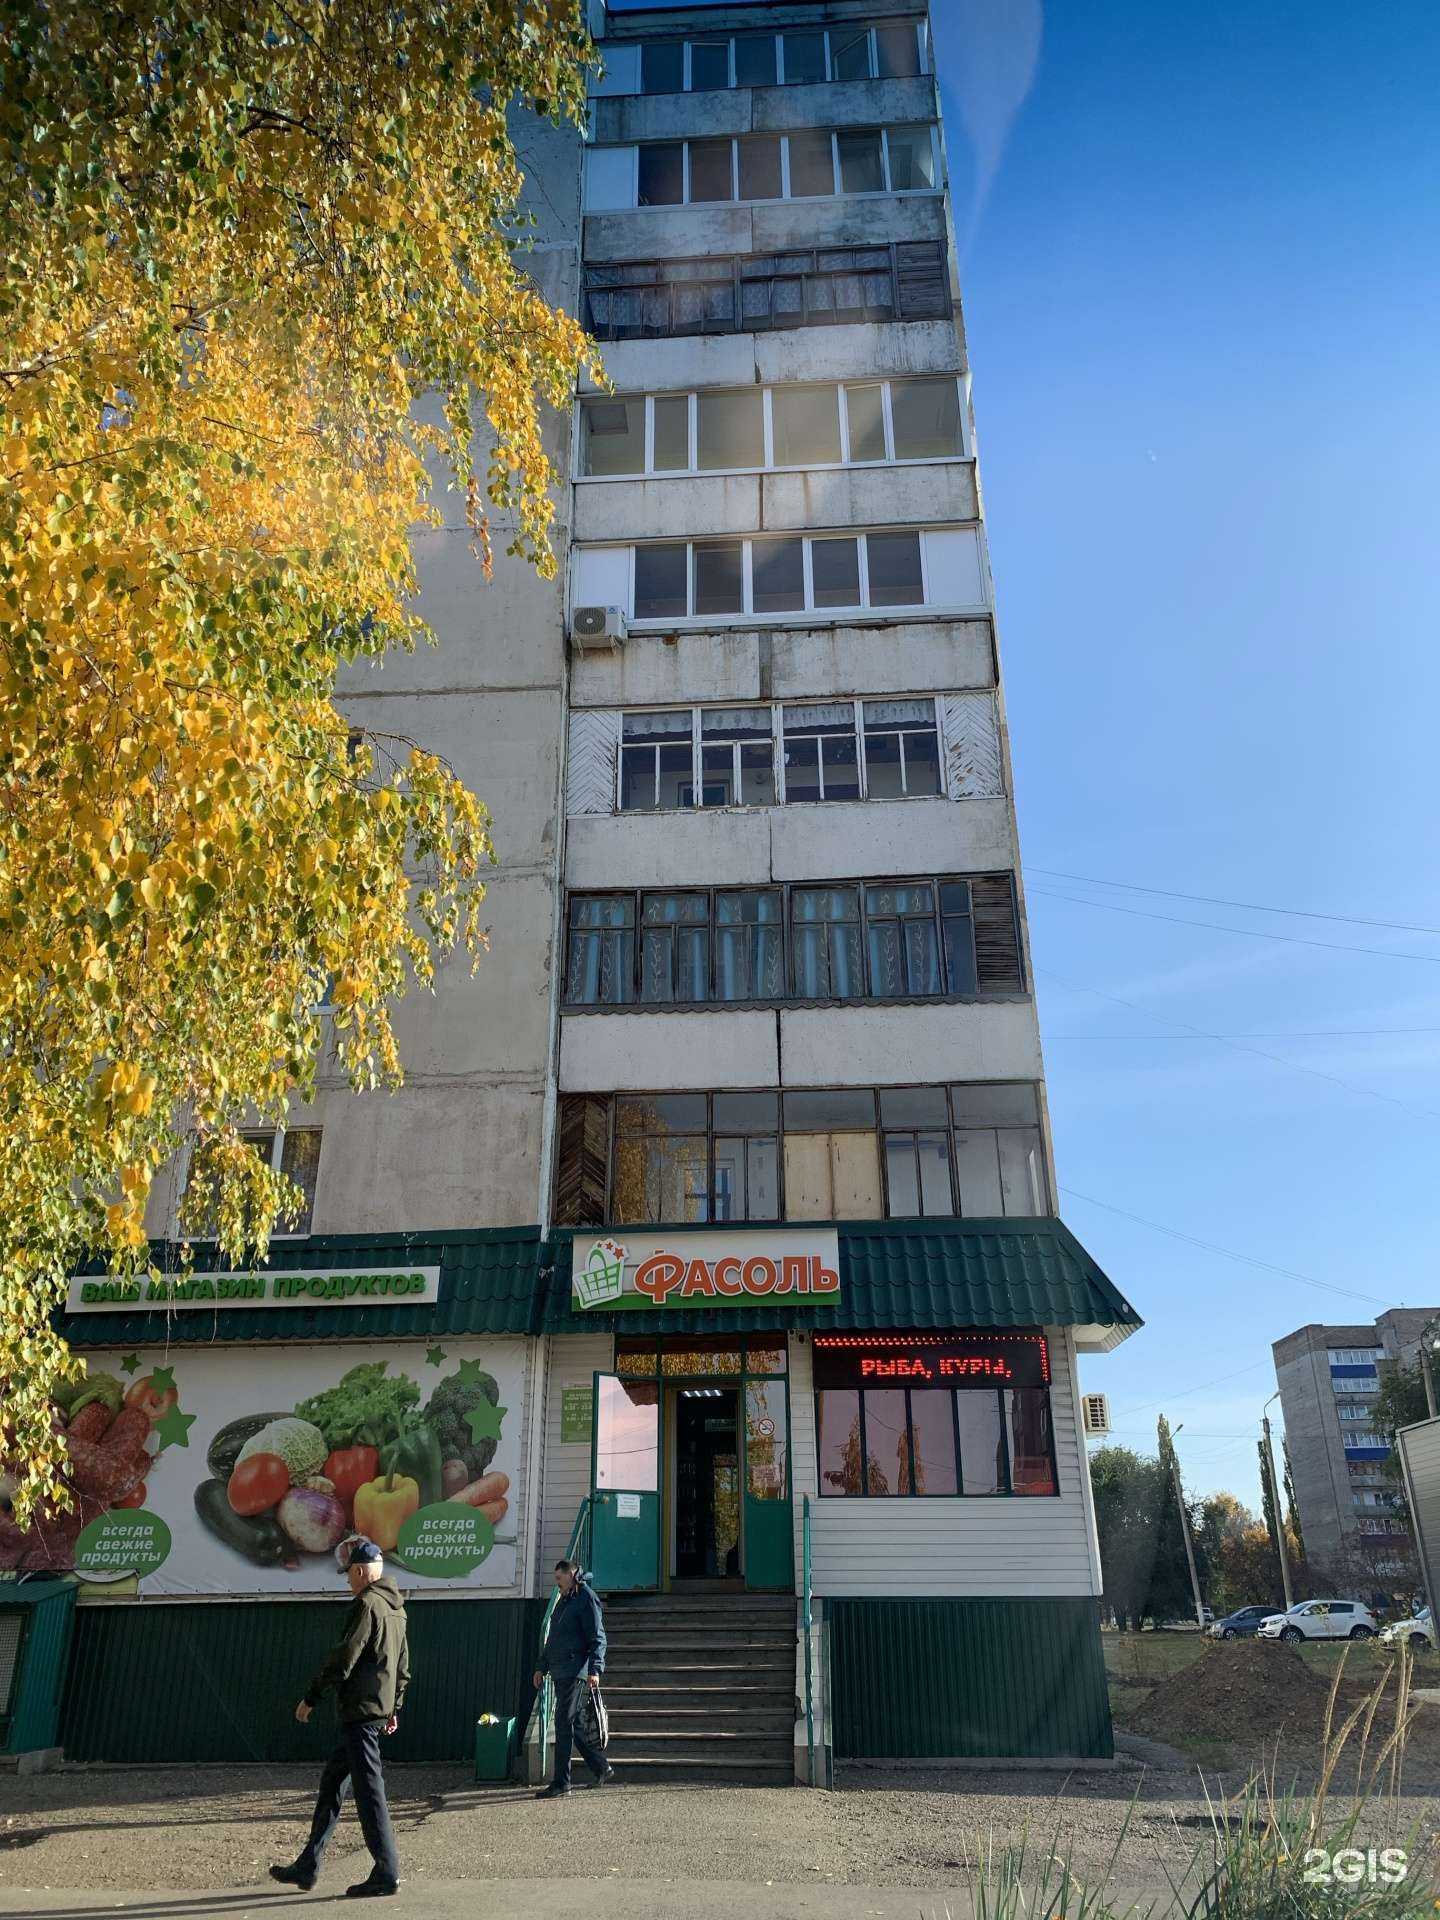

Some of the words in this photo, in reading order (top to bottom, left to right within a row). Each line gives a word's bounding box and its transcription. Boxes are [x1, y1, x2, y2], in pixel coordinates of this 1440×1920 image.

[634, 1250, 839, 1304] ФАСОЛЬ
[146, 1277, 265, 1300] МАГАЗИН
[273, 1274, 426, 1299] ПРОДУКТОВ
[861, 1359, 932, 1378] РЫБА,
[422, 1519, 475, 1531] всегда
[102, 1526, 154, 1538] всегда
[417, 1533, 477, 1544] свежие
[95, 1540, 154, 1550] свежие
[81, 1552, 160, 1565] продукты
[404, 1545, 485, 1559] продукты
